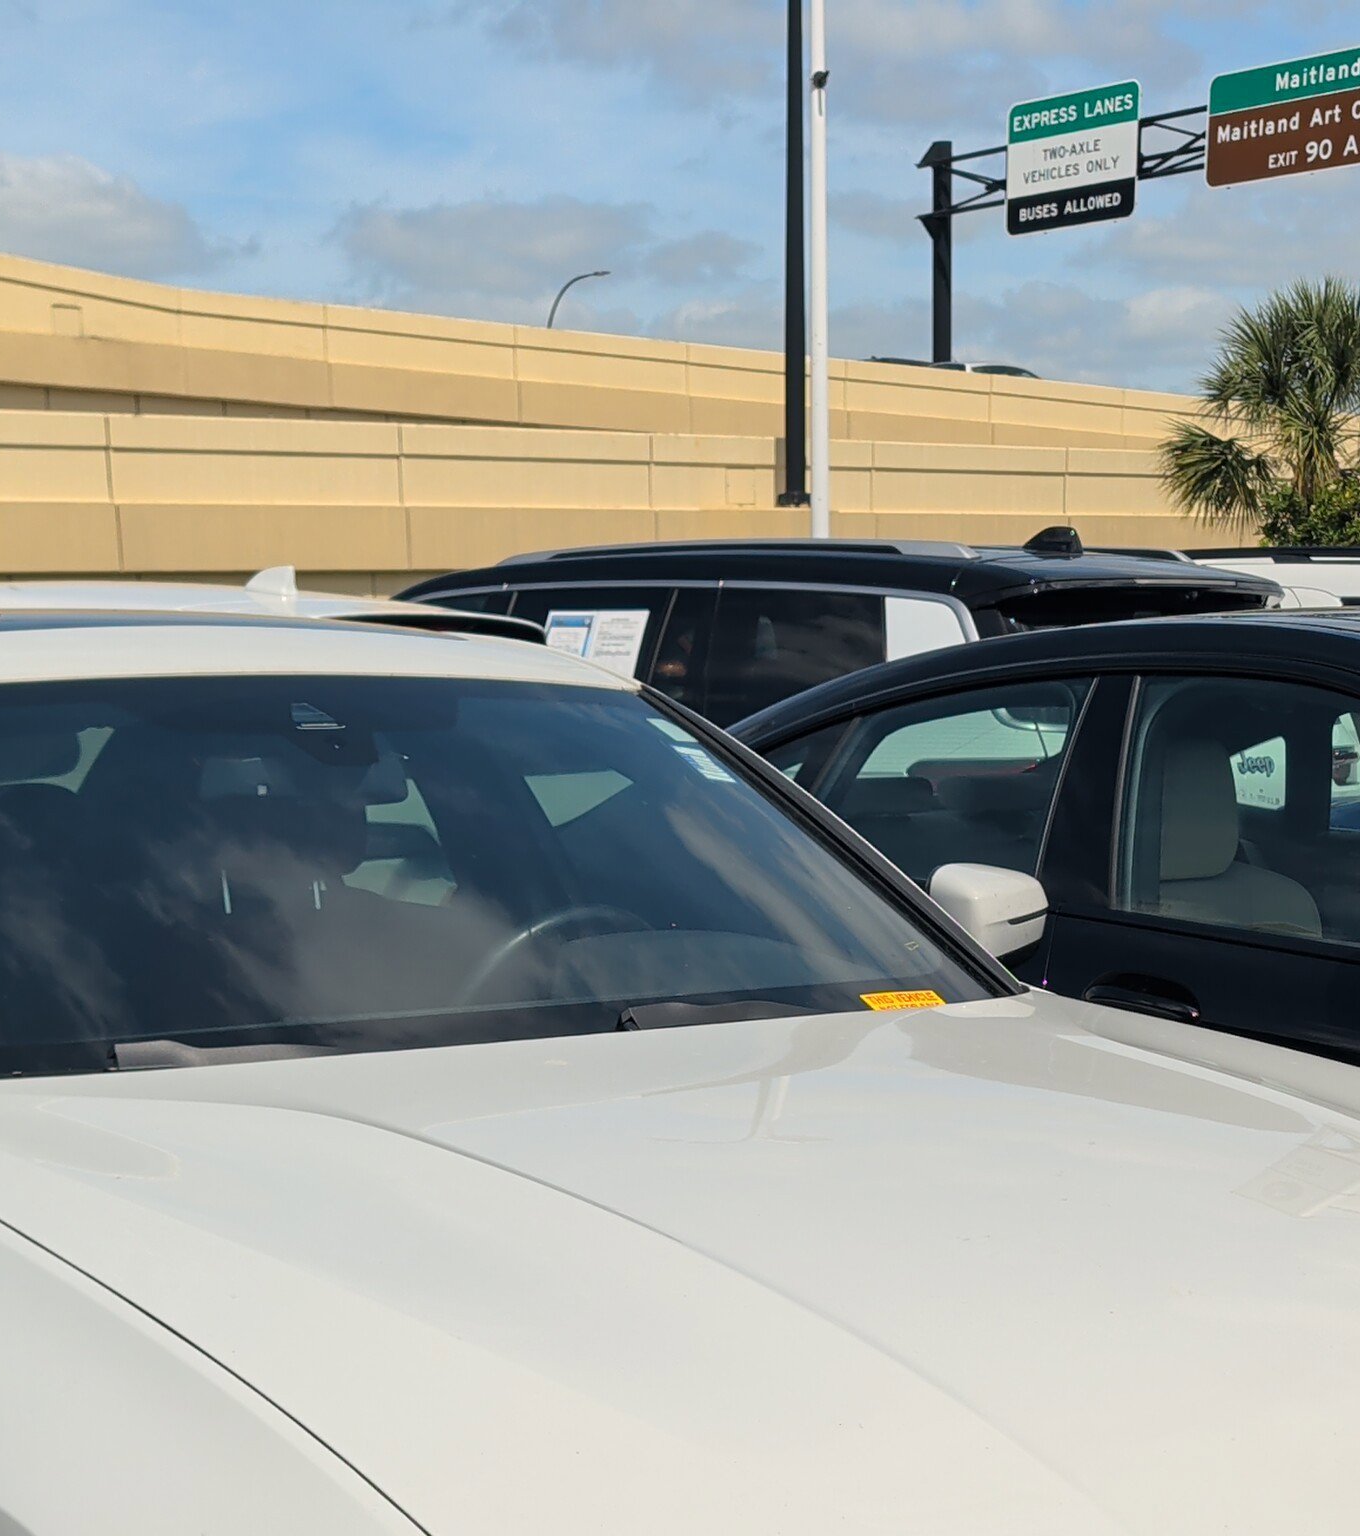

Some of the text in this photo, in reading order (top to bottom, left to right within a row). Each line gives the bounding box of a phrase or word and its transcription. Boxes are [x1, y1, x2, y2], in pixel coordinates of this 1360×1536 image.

[1013, 93, 1134, 132] EXPRESS LANES
[1216, 111, 1300, 144] Maitland
[1309, 107, 1342, 128] Art
[1043, 139, 1101, 161] TWO-AXLE
[1268, 134, 1359, 169] EXIT 90 A
[1023, 156, 1120, 184] VEHICLES ONLY
[1019, 192, 1122, 222] BUSES ALLOWED
[1237, 751, 1276, 779] Jeep
